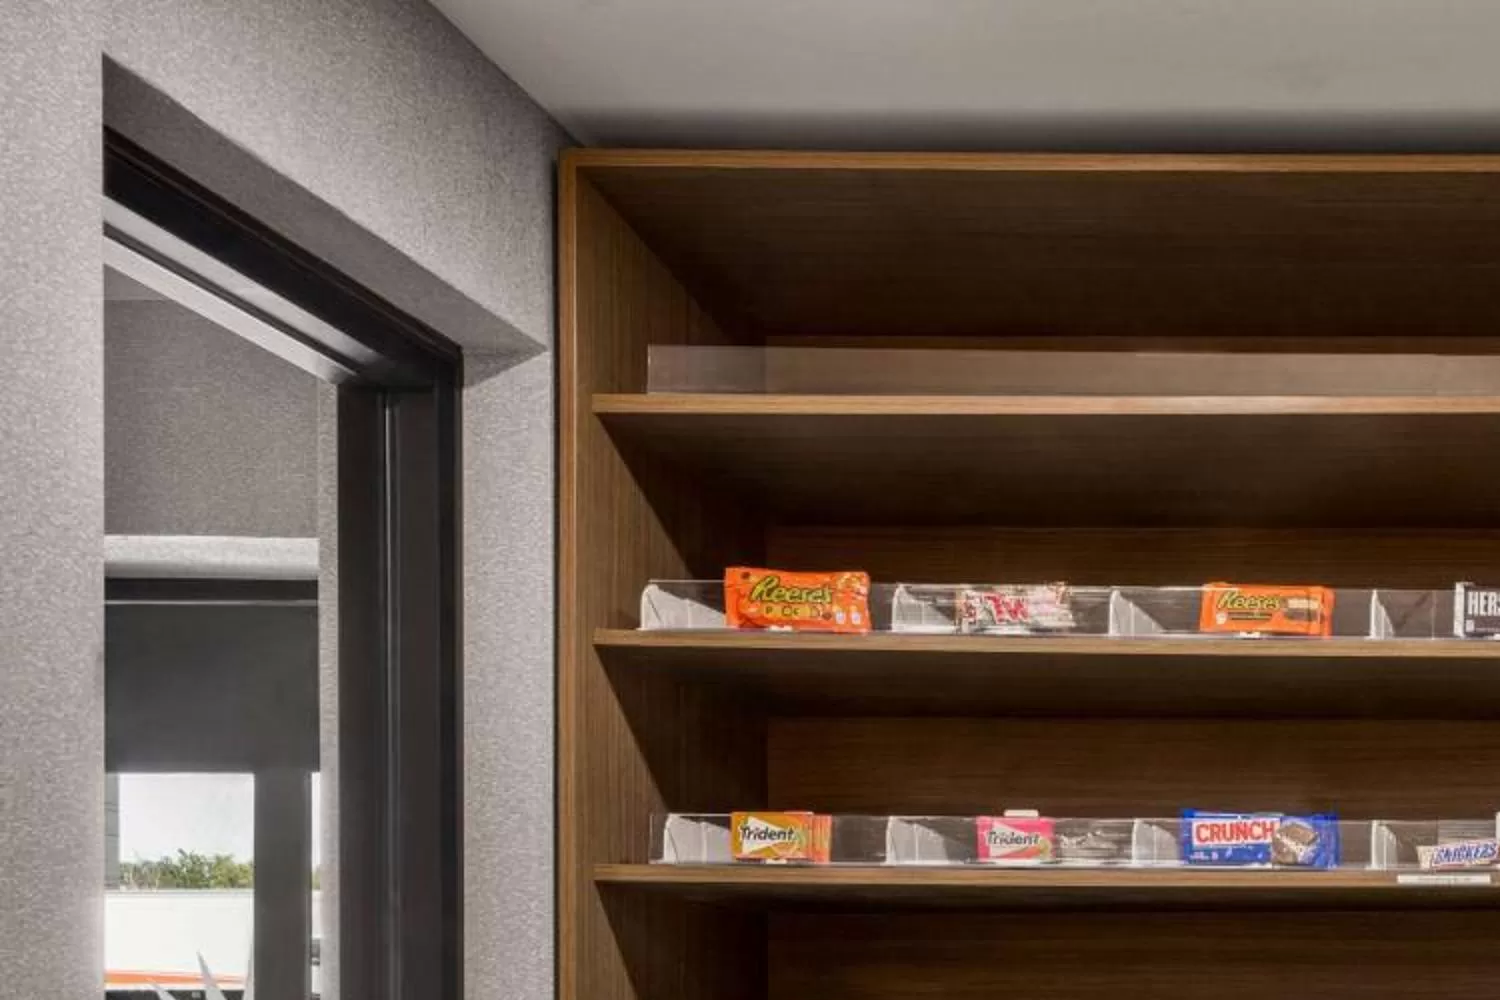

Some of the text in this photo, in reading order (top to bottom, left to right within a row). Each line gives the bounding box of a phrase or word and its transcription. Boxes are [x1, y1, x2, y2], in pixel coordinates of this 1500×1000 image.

[750, 576, 832, 603] Reese's
[740, 826, 794, 842] Trident
[987, 831, 1039, 846] Trident
[1195, 822, 1275, 843] CRUNCH
